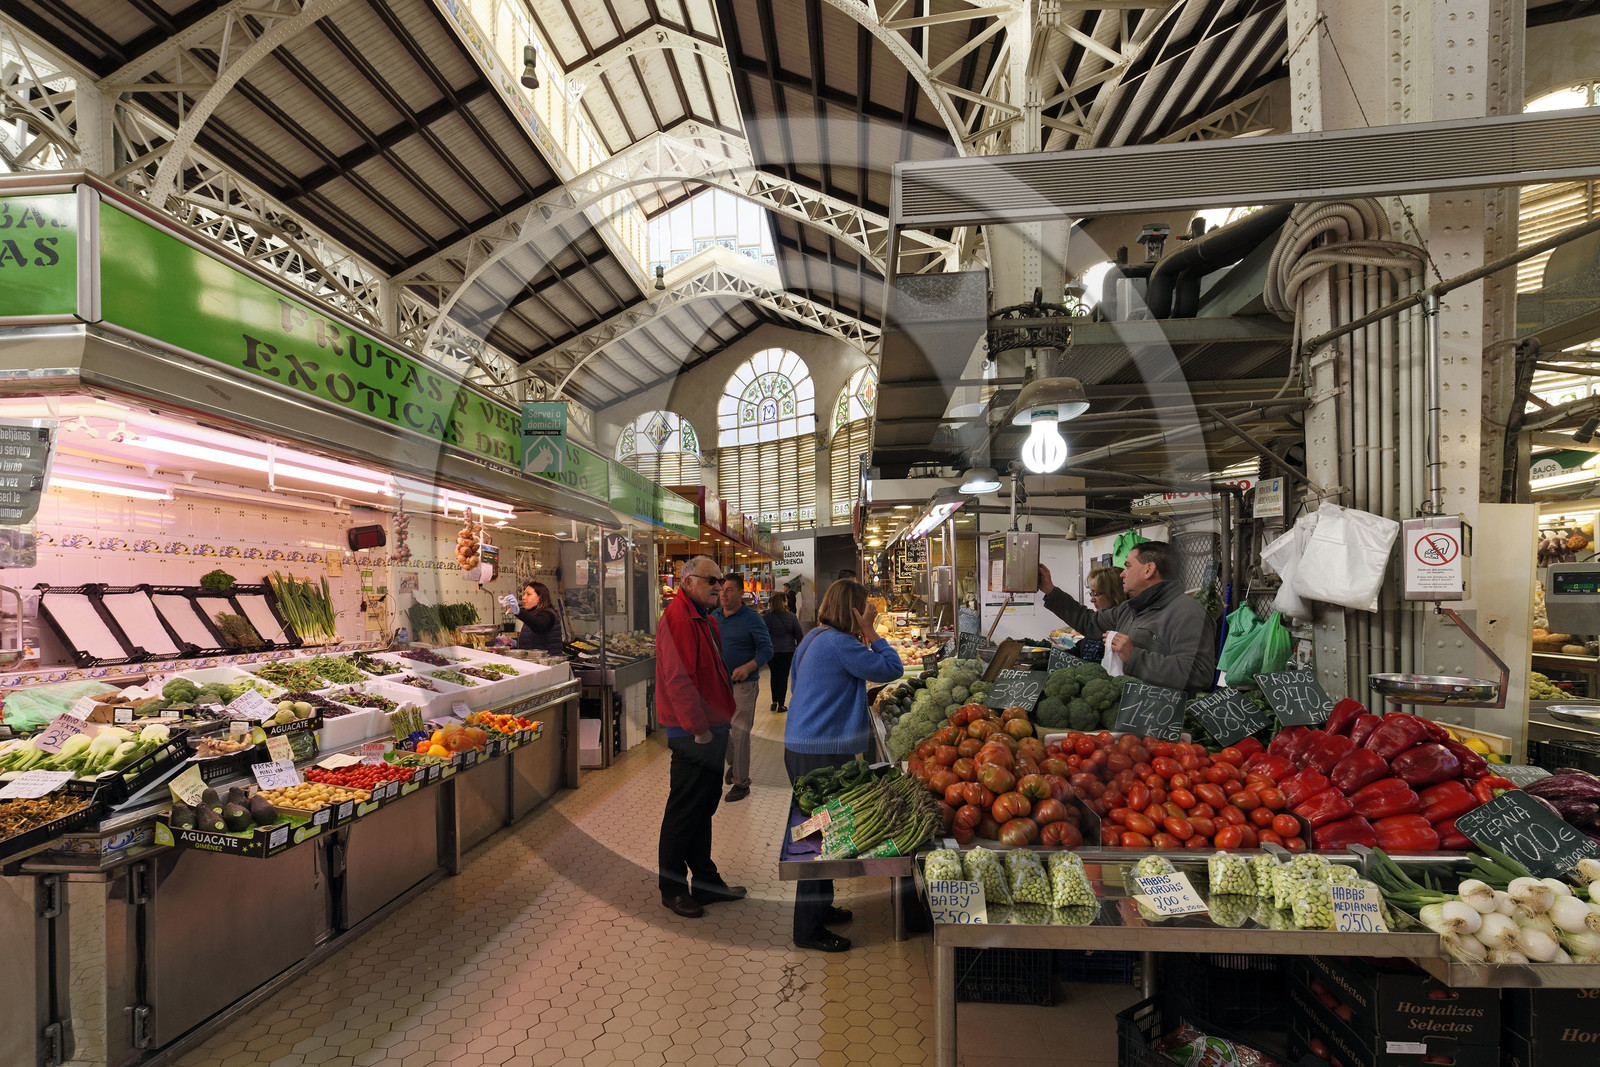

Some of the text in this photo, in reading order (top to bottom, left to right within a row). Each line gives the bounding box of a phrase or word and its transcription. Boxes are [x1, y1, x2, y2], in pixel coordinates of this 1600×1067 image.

[277, 298, 442, 401] FRUTAS
[453, 389, 469, 415] Y
[242, 334, 464, 444] EXOTICAS
[528, 409, 554, 418] Servei
[528, 420, 561, 429] domicili
[5, 445, 31, 458] serving
[1533, 464, 1556, 474] BAJOS
[6, 477, 19, 487] vez
[0, 508, 23, 518] ummer
[998, 669, 1031, 679] RAFF
[1187, 685, 1239, 716] ITALIANOS
[271, 720, 309, 735] AGUACATE
[1146, 725, 1180, 740] KILO
[1460, 795, 1517, 833] CEBOLLA
[1470, 805, 1531, 841] TIERNA
[180, 831, 238, 848] AGUACATE
[1138, 874, 1171, 887] HABAS
[931, 881, 980, 895] HABAS
[1144, 882, 1183, 895] GORDAS
[1332, 887, 1364, 900] HABAS
[931, 895, 970, 908] BABY
[1334, 902, 1378, 912] MEDIANAS
[1331, 970, 1367, 1007] Selectas
[1396, 1001, 1485, 1017] Hortalizas
[1408, 1018, 1474, 1033] Selectas
